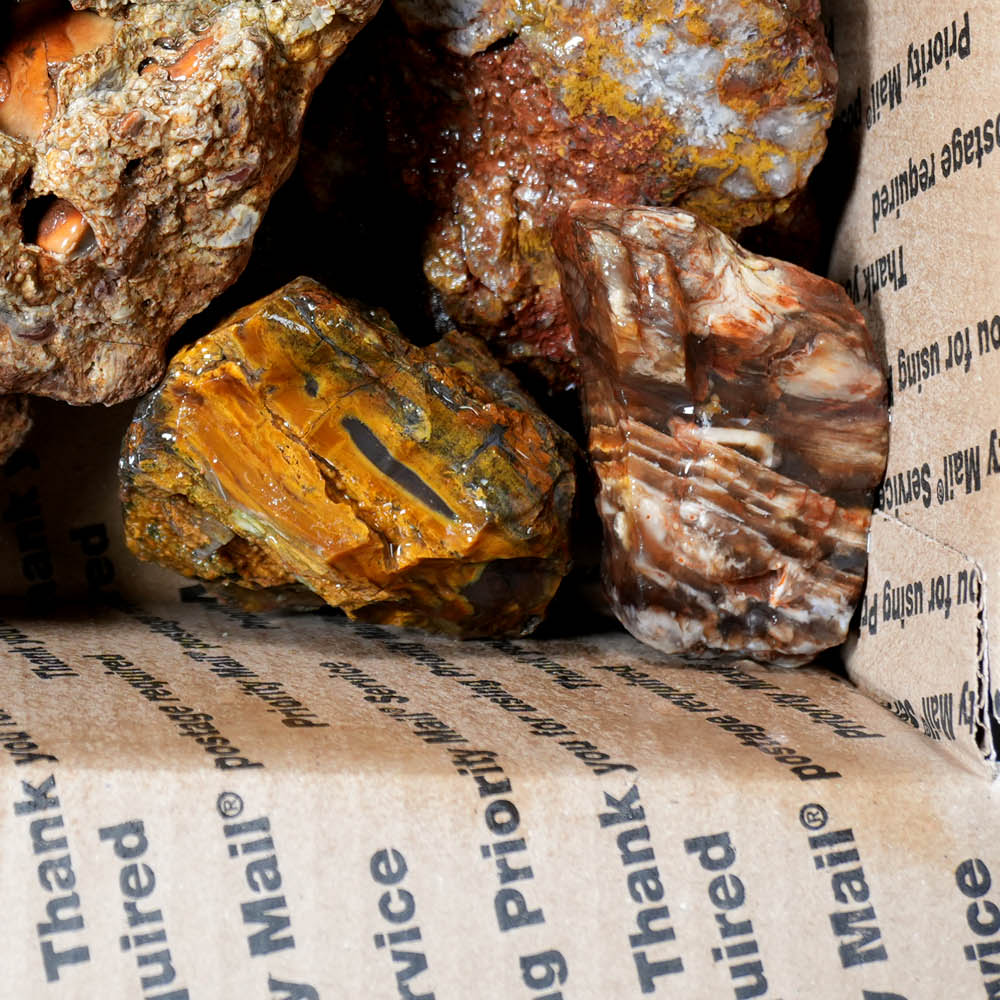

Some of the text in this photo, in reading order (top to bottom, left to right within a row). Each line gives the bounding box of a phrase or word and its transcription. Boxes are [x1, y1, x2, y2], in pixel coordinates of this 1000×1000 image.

[906, 10, 971, 89] Priority
[871, 153, 936, 234] required
[862, 245, 908, 307] Thank
[897, 327, 973, 395] for using
[936, 445, 982, 506] Mail®
[882, 579, 924, 630] using
[927, 574, 953, 620] for
[556, 739, 638, 776] you
[13, 774, 92, 983] Thank
[216, 790, 297, 959] Mail®
[446, 747, 547, 933] Priority
[597, 783, 686, 994] Thank
[799, 803, 889, 968] Mail®
